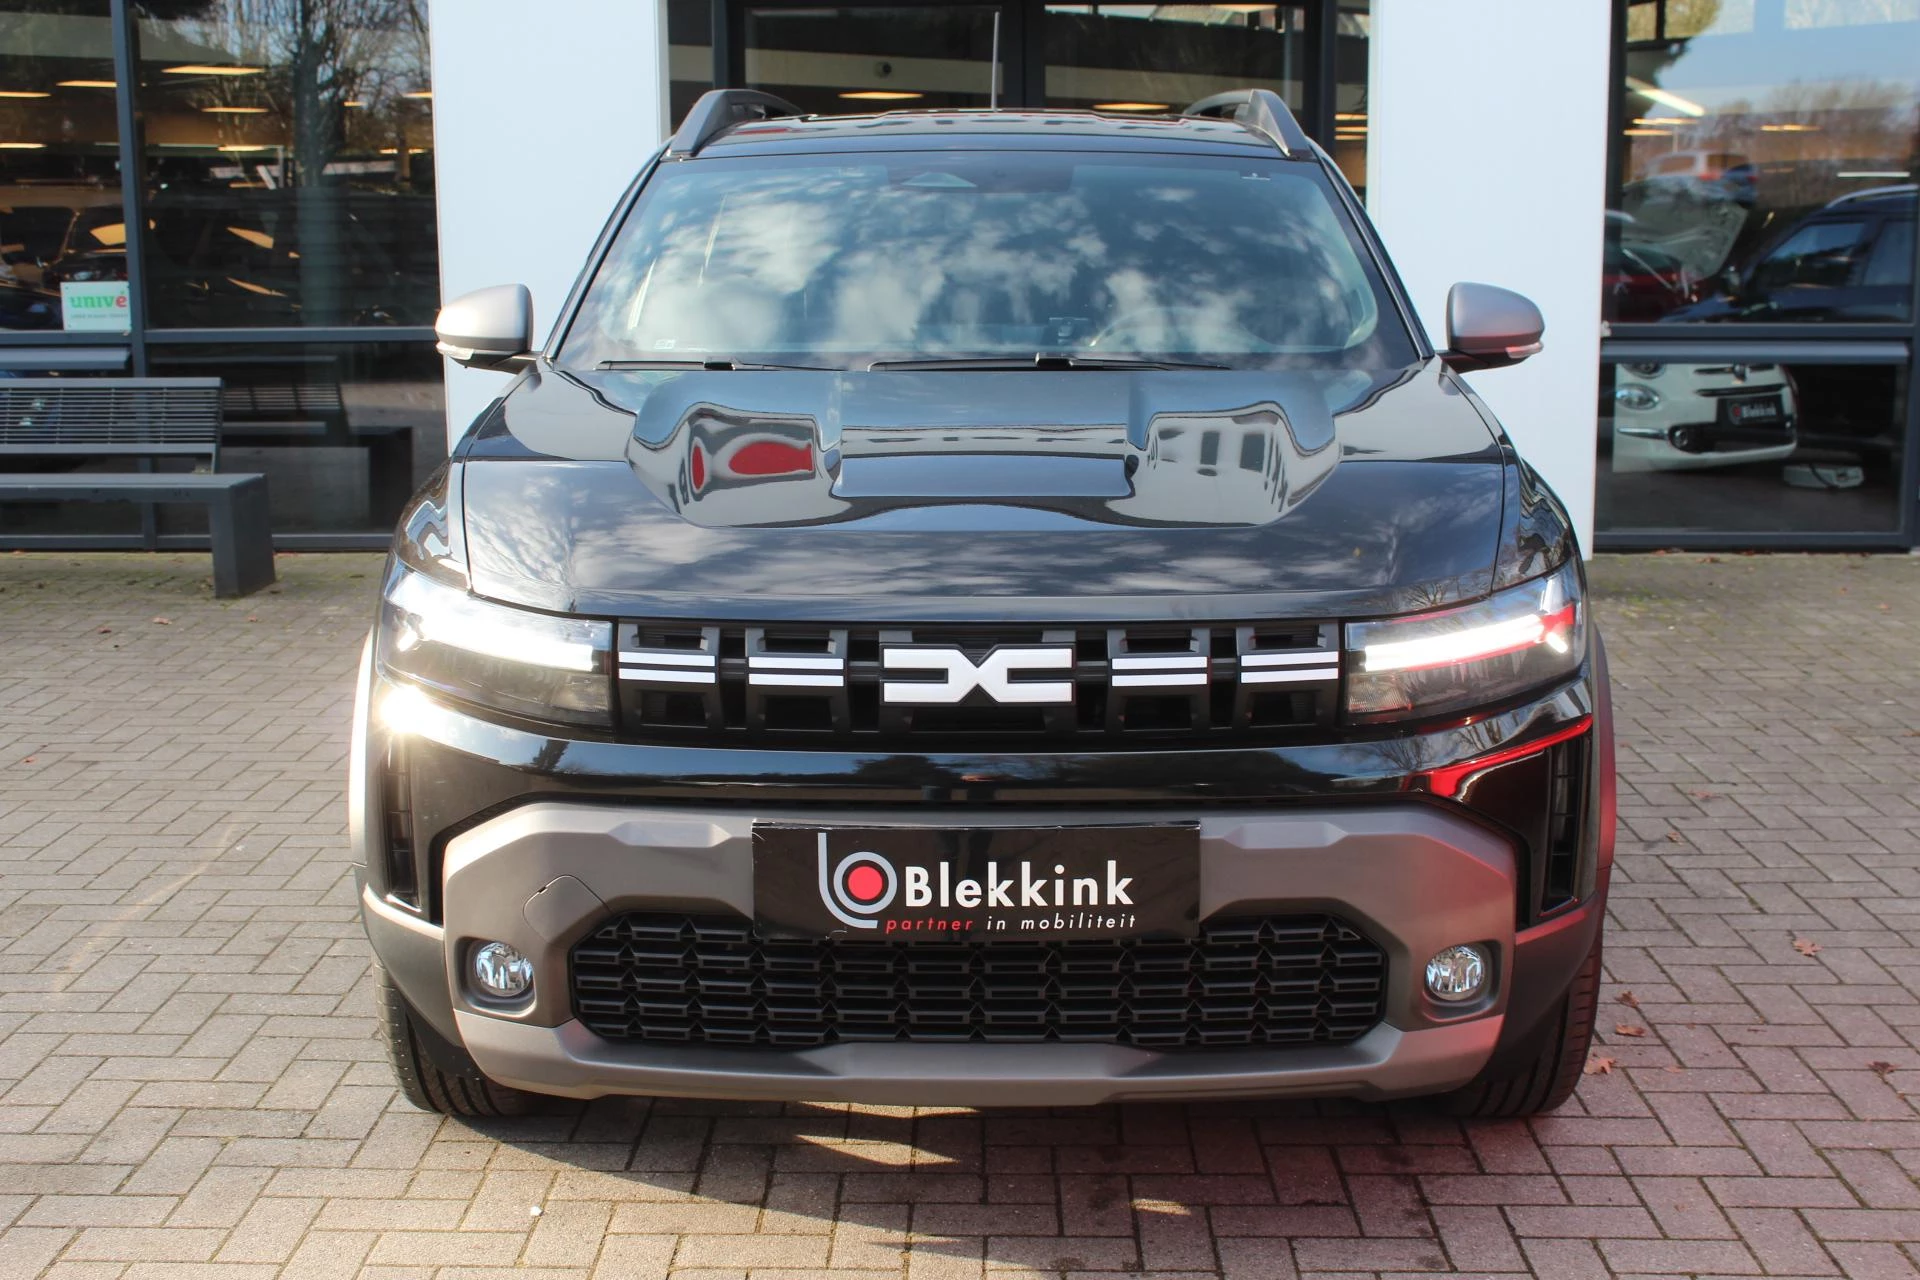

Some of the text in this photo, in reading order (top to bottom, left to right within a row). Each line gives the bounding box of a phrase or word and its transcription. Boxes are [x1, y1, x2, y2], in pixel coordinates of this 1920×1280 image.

[905, 860, 1134, 908] Blekkink
[885, 912, 1136, 934] partner in mobiliteit
